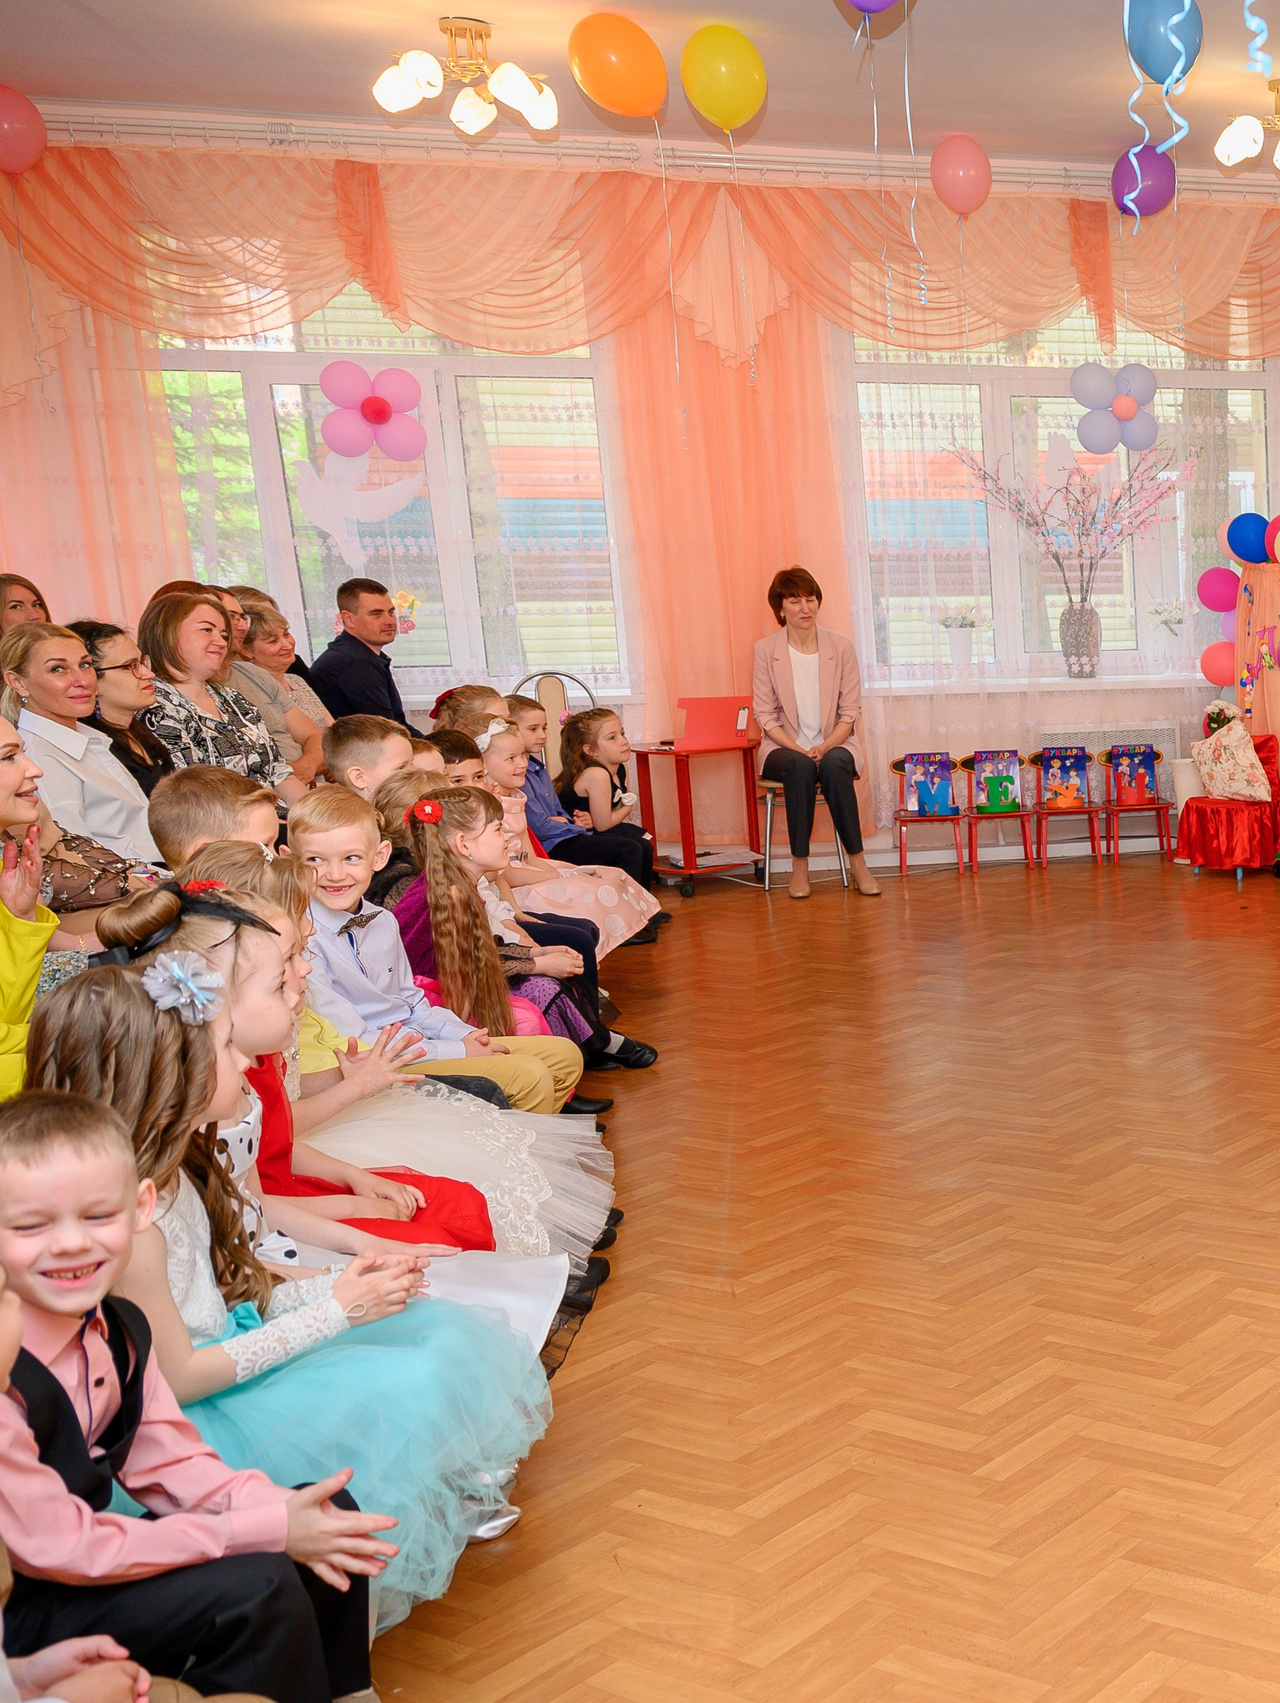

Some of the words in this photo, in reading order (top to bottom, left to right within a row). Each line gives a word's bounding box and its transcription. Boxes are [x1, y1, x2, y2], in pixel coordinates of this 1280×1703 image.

[1044, 748, 1083, 757] БУКВАРЬ
[1113, 746, 1151, 754] БУКВАРЬ
[906, 754, 947, 763] БУКВАРЬ
[976, 752, 1016, 761] БУКВАРЬ
